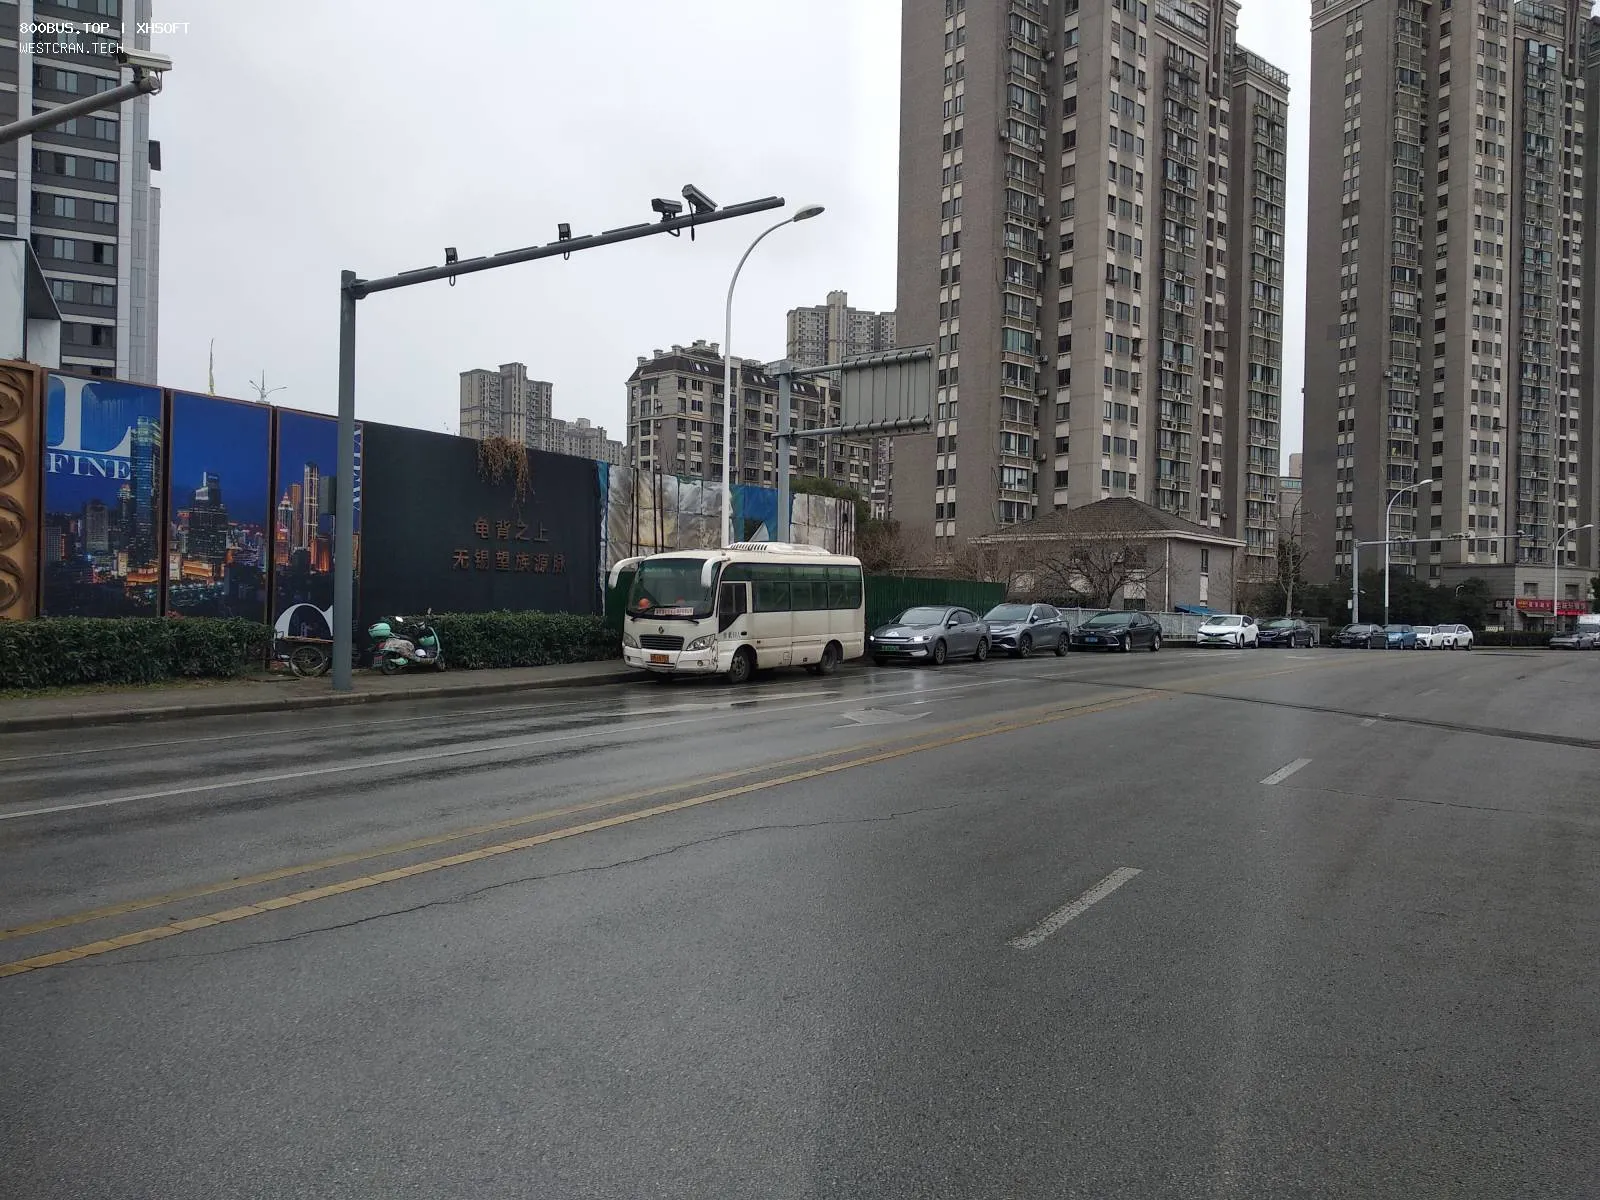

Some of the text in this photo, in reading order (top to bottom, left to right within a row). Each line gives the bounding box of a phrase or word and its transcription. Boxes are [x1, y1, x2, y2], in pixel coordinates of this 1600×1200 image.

[47, 374, 131, 458] L
[47, 452, 131, 480] FINE
[473, 516, 550, 542] 龟背之上
